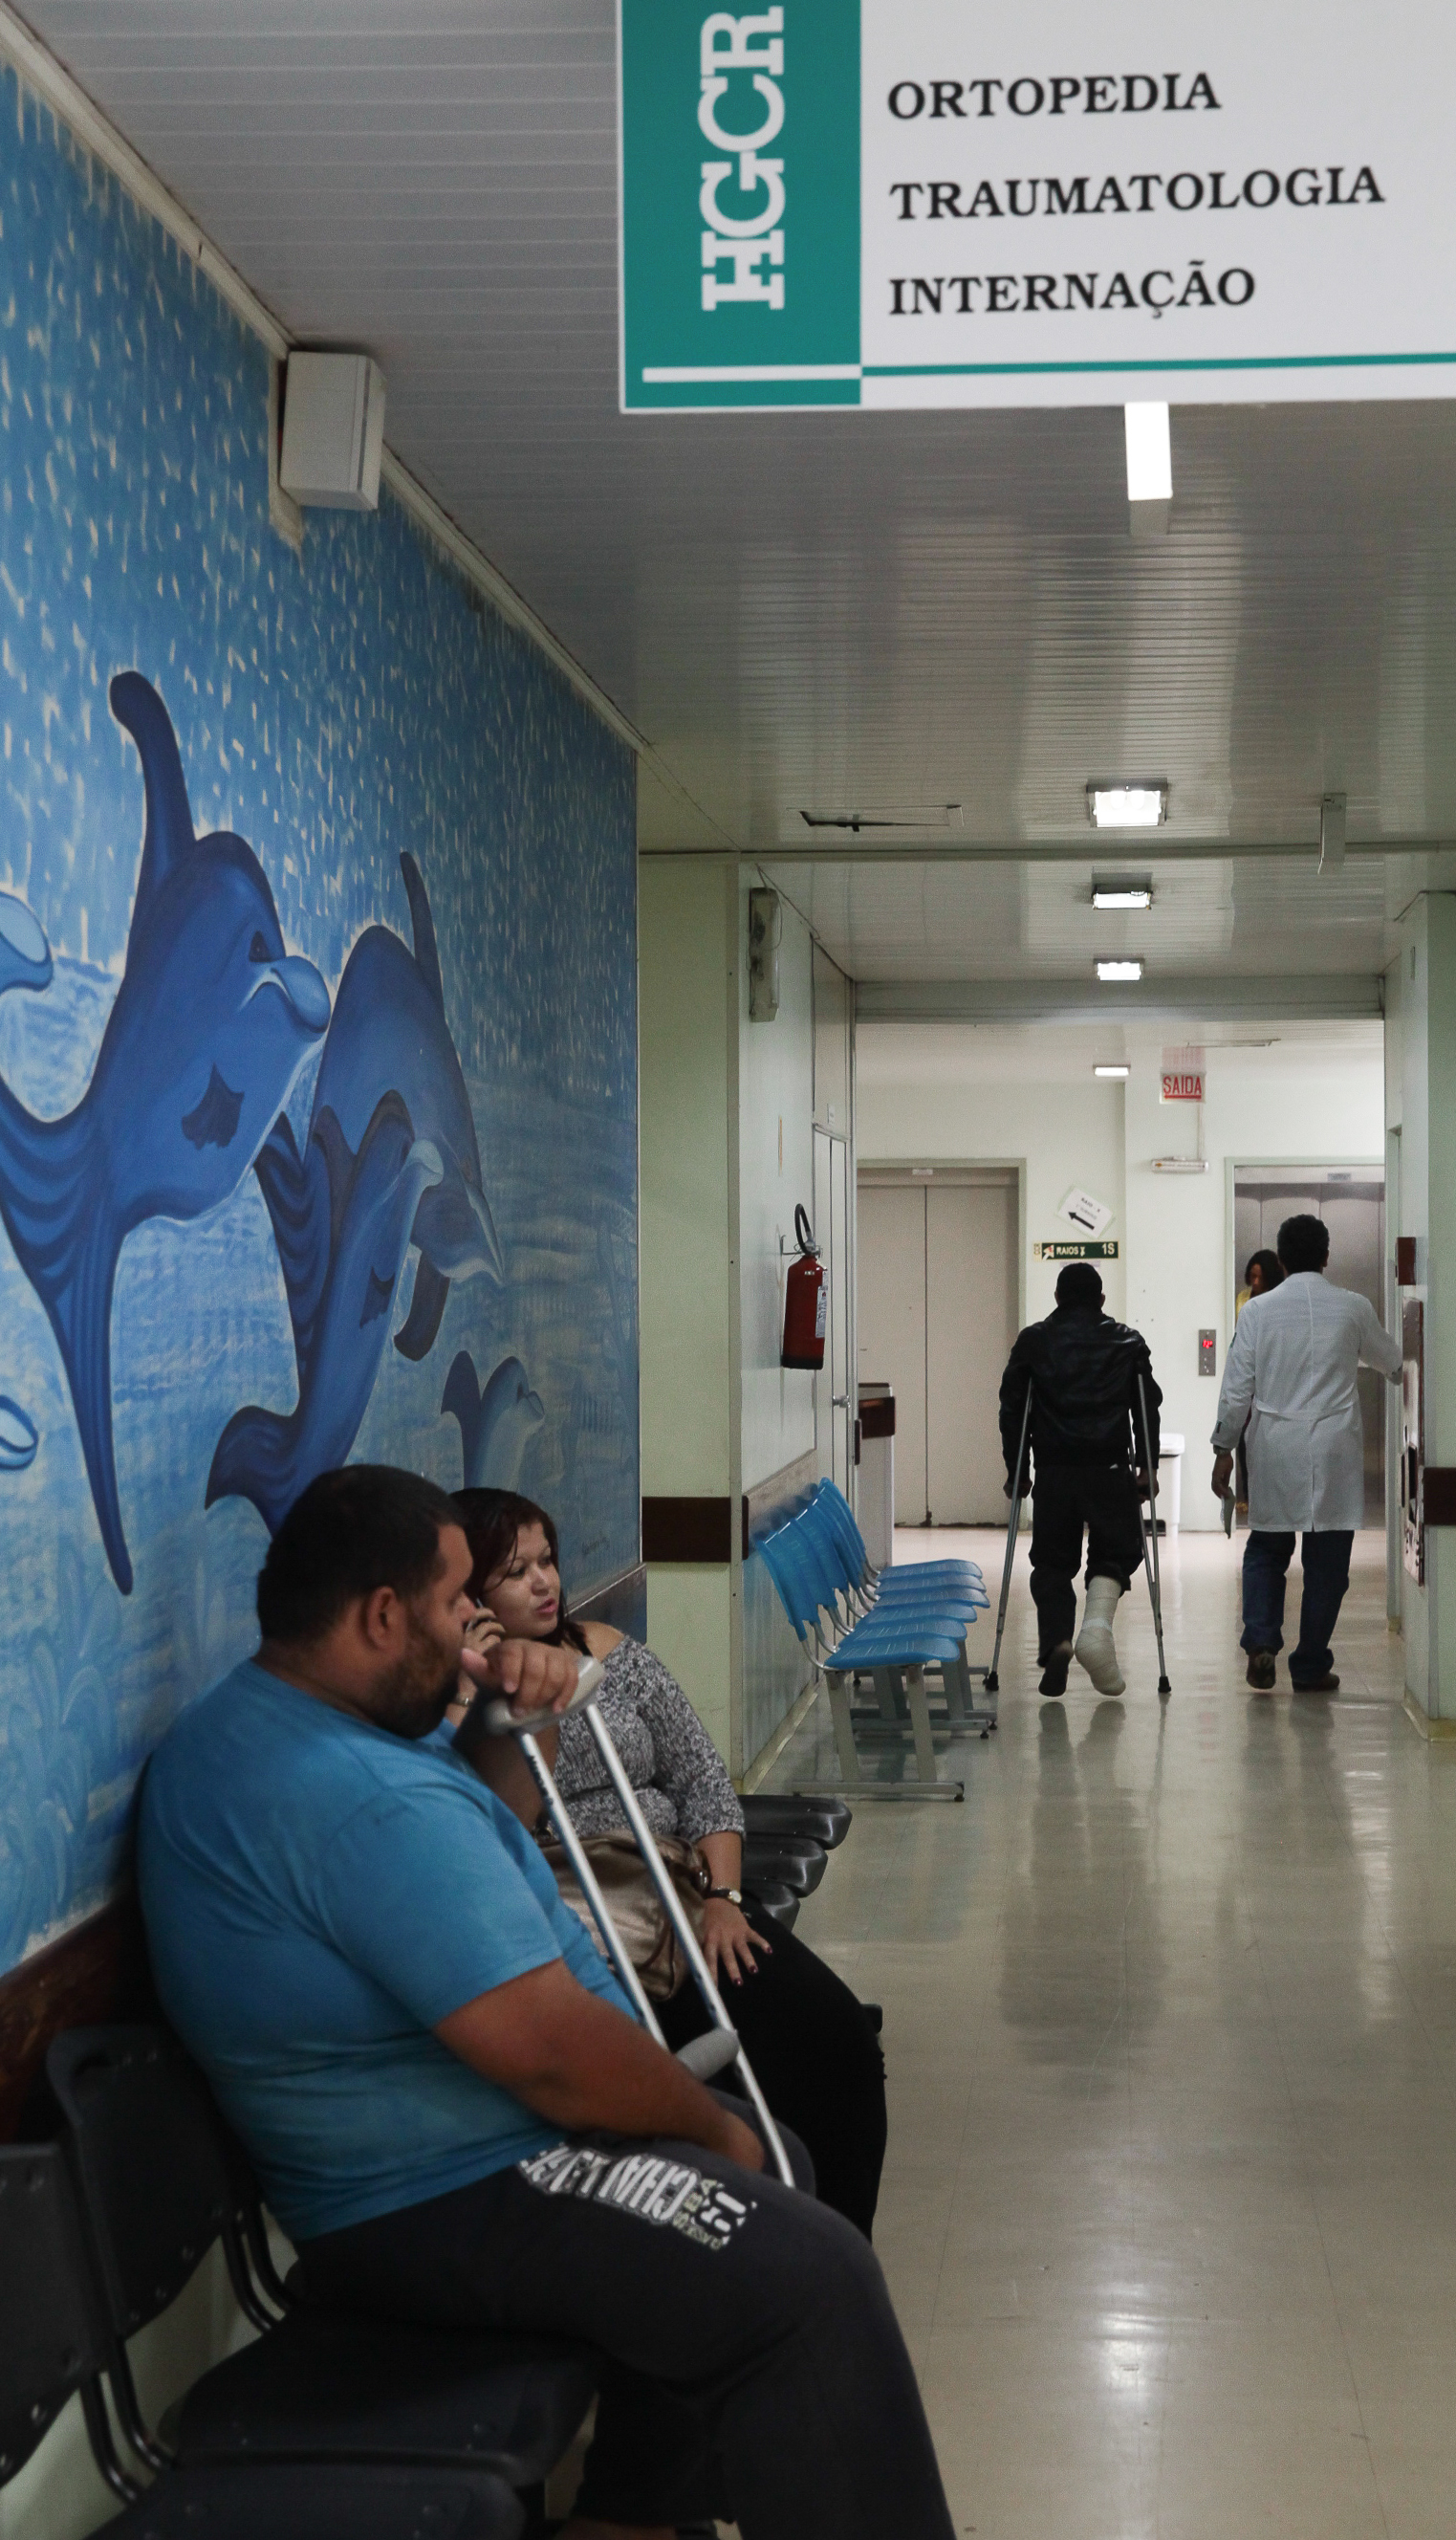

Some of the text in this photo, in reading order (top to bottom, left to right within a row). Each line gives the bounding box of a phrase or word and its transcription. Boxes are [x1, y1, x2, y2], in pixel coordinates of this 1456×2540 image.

[887, 72, 1222, 120] ORTOPEDIA
[698, 6, 785, 311] HGCR
[889, 166, 1386, 220] TRAUMATOLOGIA
[889, 259, 1256, 319] INTERNAÇÃO
[1055, 1246, 1079, 1256] RAIOS
[1101, 1242, 1116, 1256] 1S
